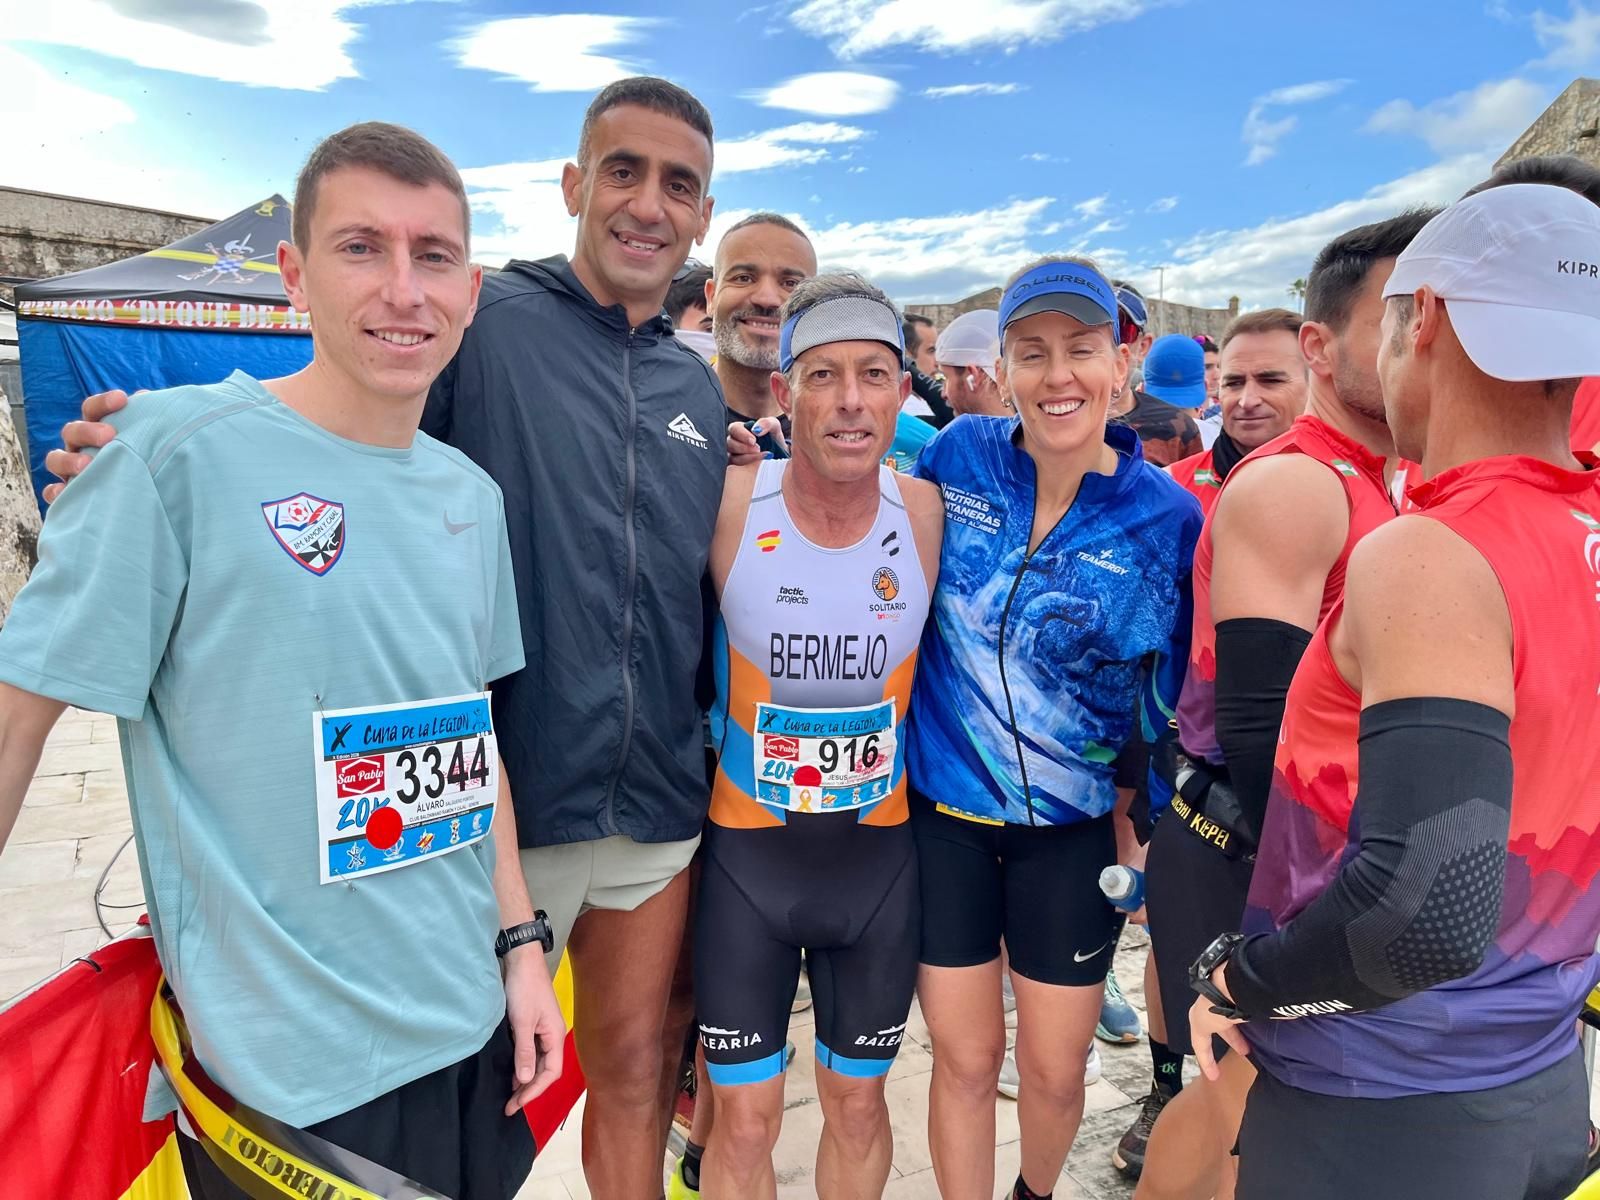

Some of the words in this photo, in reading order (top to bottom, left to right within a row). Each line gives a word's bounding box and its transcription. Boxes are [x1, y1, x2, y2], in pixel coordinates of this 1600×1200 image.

[1557, 260, 1599, 279] KIPR
[1032, 274, 1105, 299] LURBEL
[238, 302, 273, 329] DE
[666, 430, 685, 442] NIKE
[686, 437, 708, 450] TRAIL
[944, 490, 990, 512] NUTRIAS
[1076, 551, 1129, 576] TEAMERGY
[775, 594, 809, 605] projects
[779, 585, 804, 596] tactic
[868, 602, 907, 612] SOLITARIO
[770, 632, 888, 681] BERMEJO
[331, 721, 352, 753] X
[764, 742, 778, 751] San
[779, 744, 799, 755] Pablo
[818, 734, 880, 774] 916
[337, 772, 357, 785] San
[357, 767, 385, 781] Pablo
[395, 736, 490, 805] 3344
[1272, 999, 1354, 1018] KIPRUN
